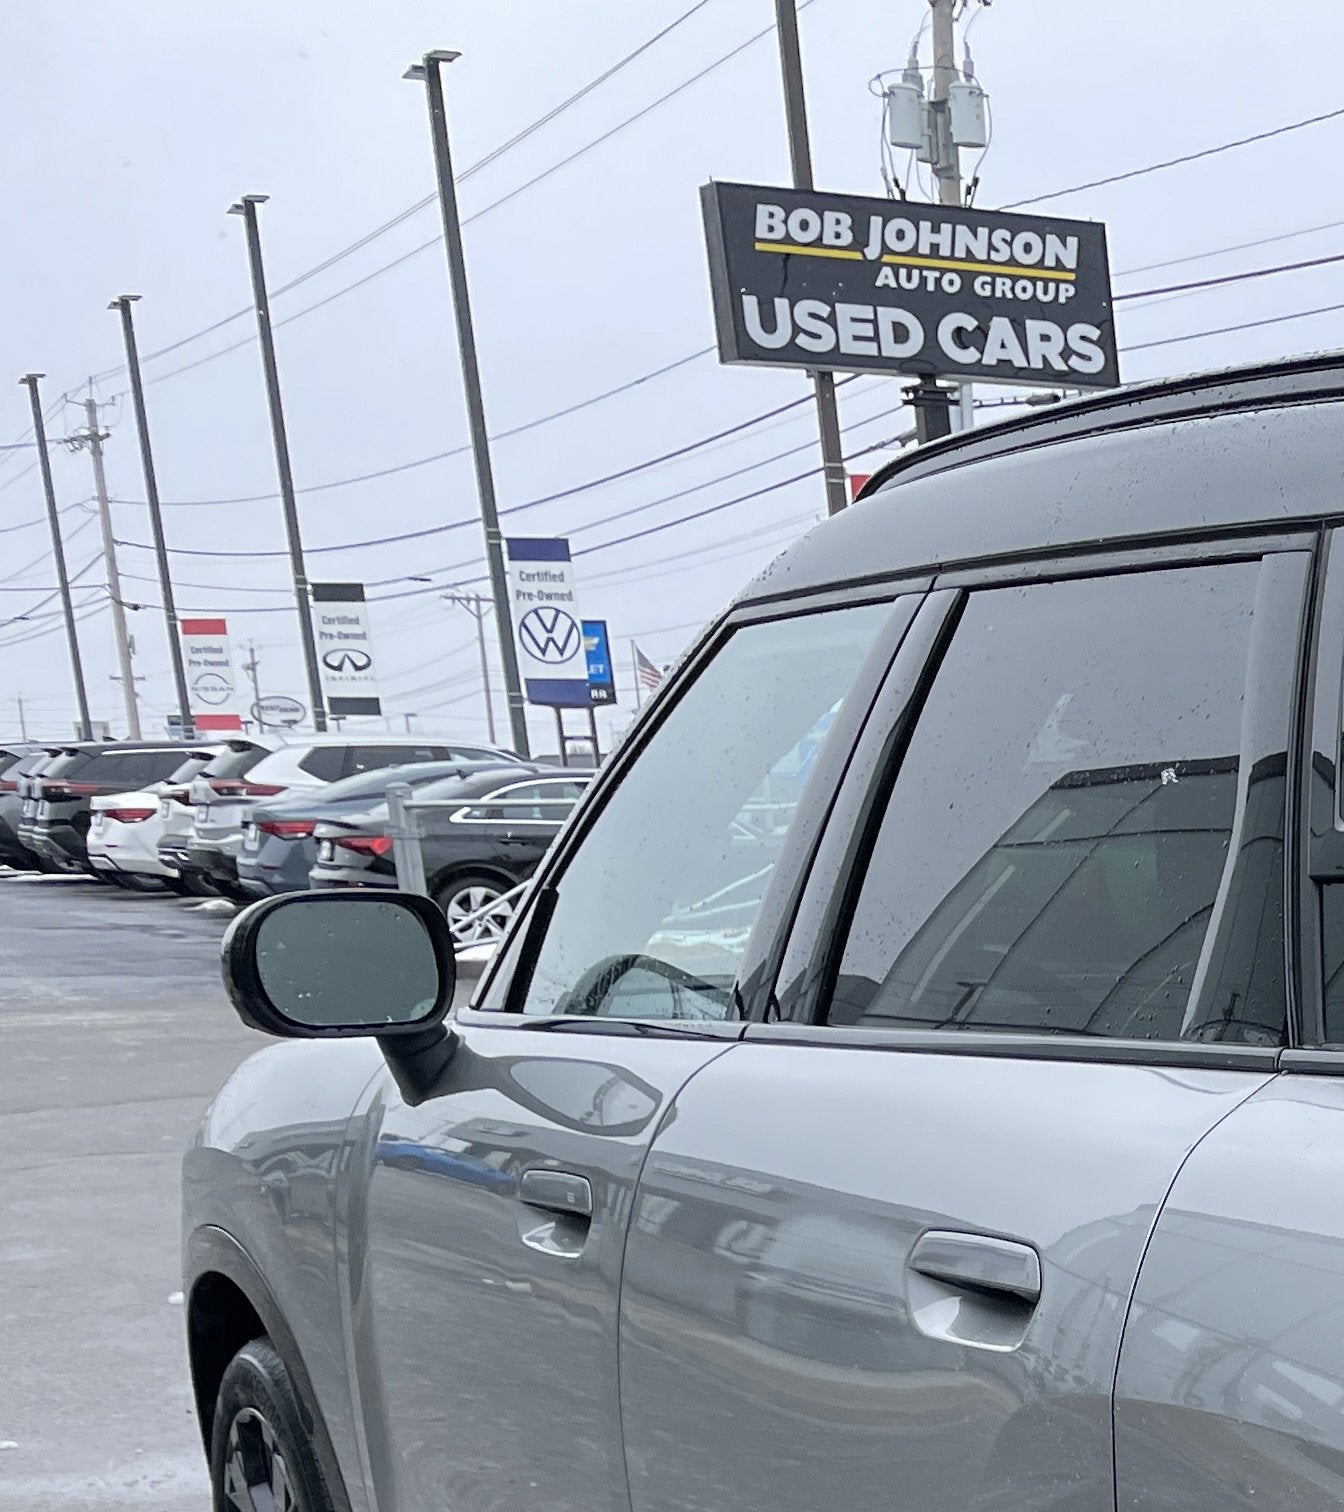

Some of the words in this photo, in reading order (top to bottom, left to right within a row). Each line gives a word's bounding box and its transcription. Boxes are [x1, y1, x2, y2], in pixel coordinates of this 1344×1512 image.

[755, 204, 853, 246] BOB
[862, 215, 1079, 269] JOHNSON
[875, 266, 961, 294] AUTO
[973, 274, 1076, 304] GROUP
[742, 295, 925, 358] USED
[937, 312, 1106, 374] CARS
[519, 571, 565, 583] Certified
[516, 589, 574, 602] Pre-Owned
[322, 615, 360, 625] Certified
